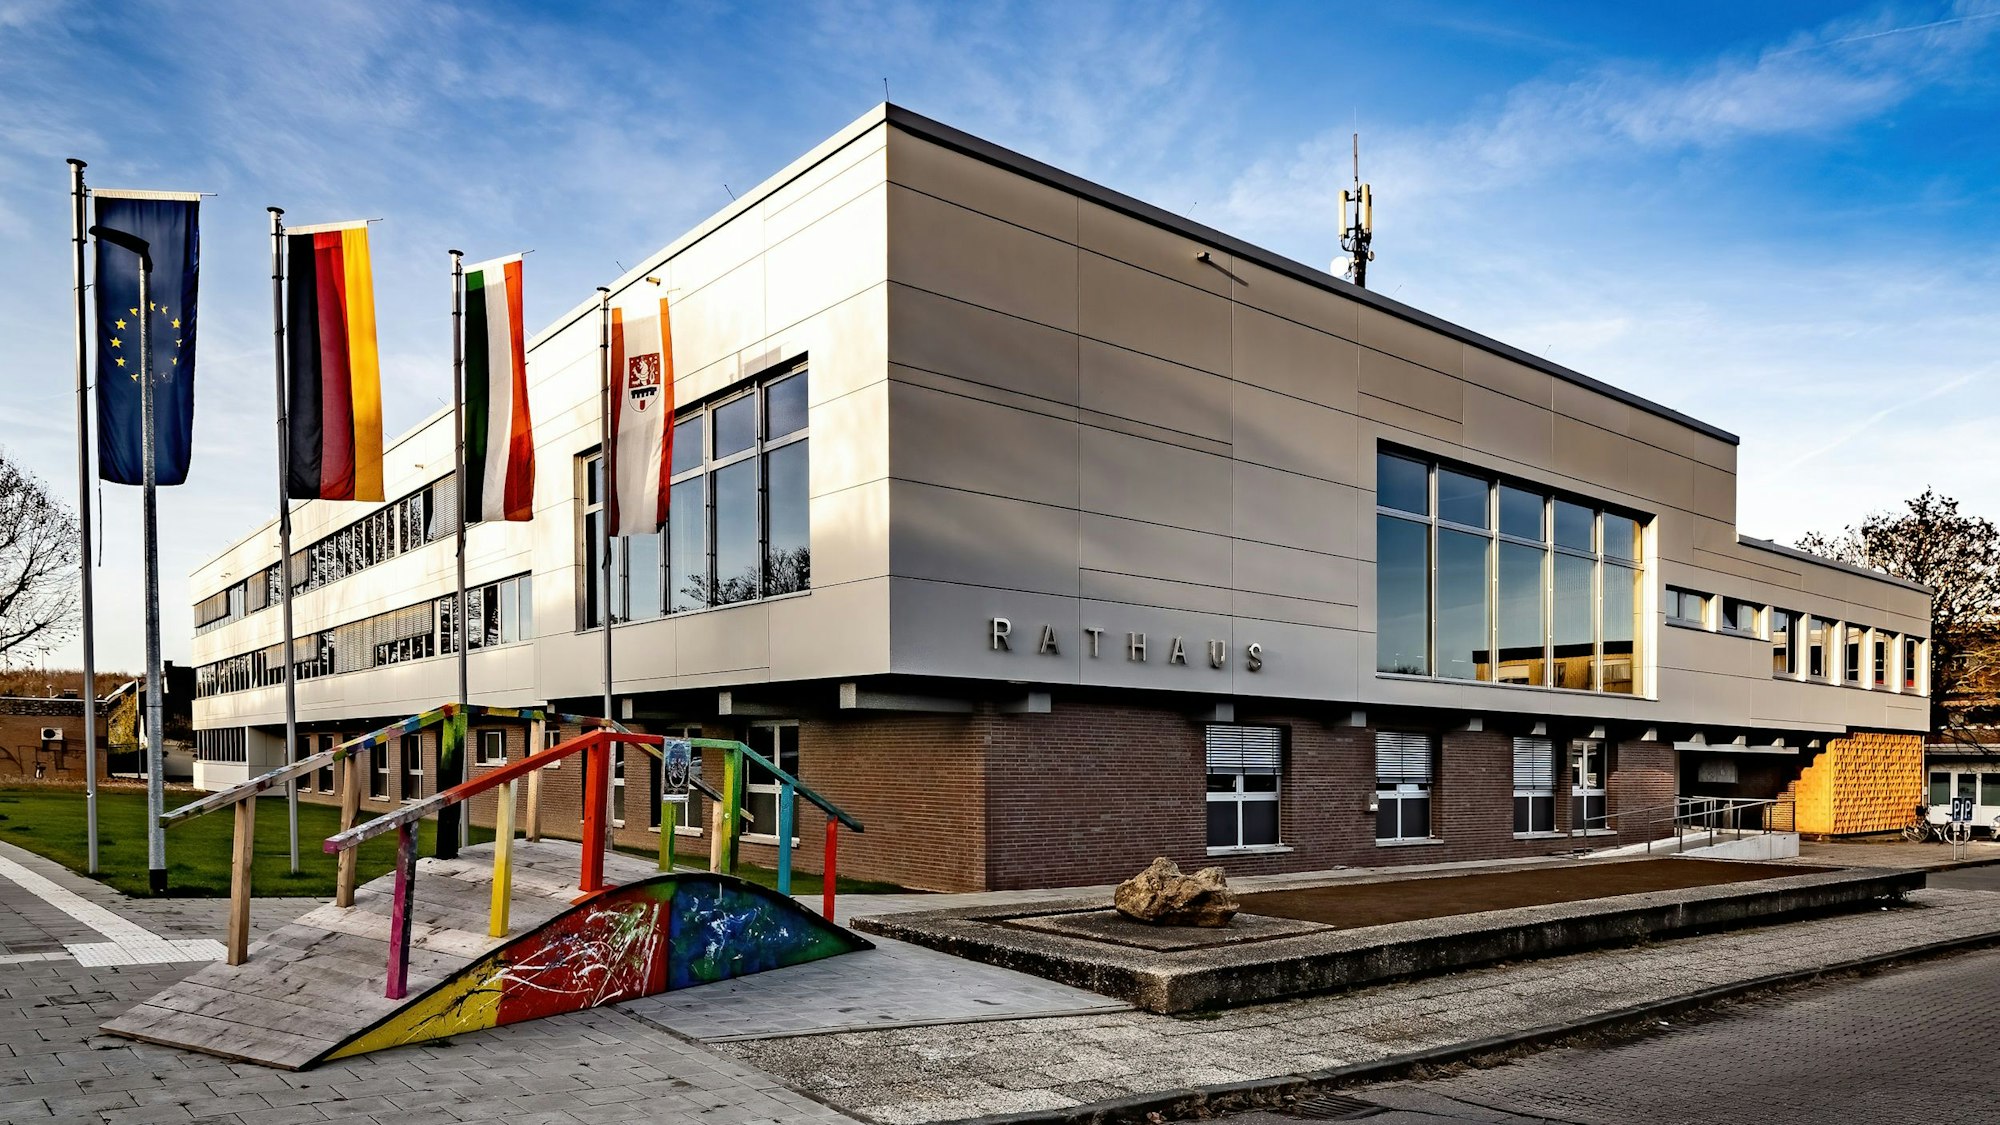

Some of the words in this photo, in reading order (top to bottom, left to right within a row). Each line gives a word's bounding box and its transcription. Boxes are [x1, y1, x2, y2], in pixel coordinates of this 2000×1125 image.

[991, 617, 1262, 671] RATHAUS
[1953, 800, 1960, 819] P
[1964, 800, 1971, 819] P
